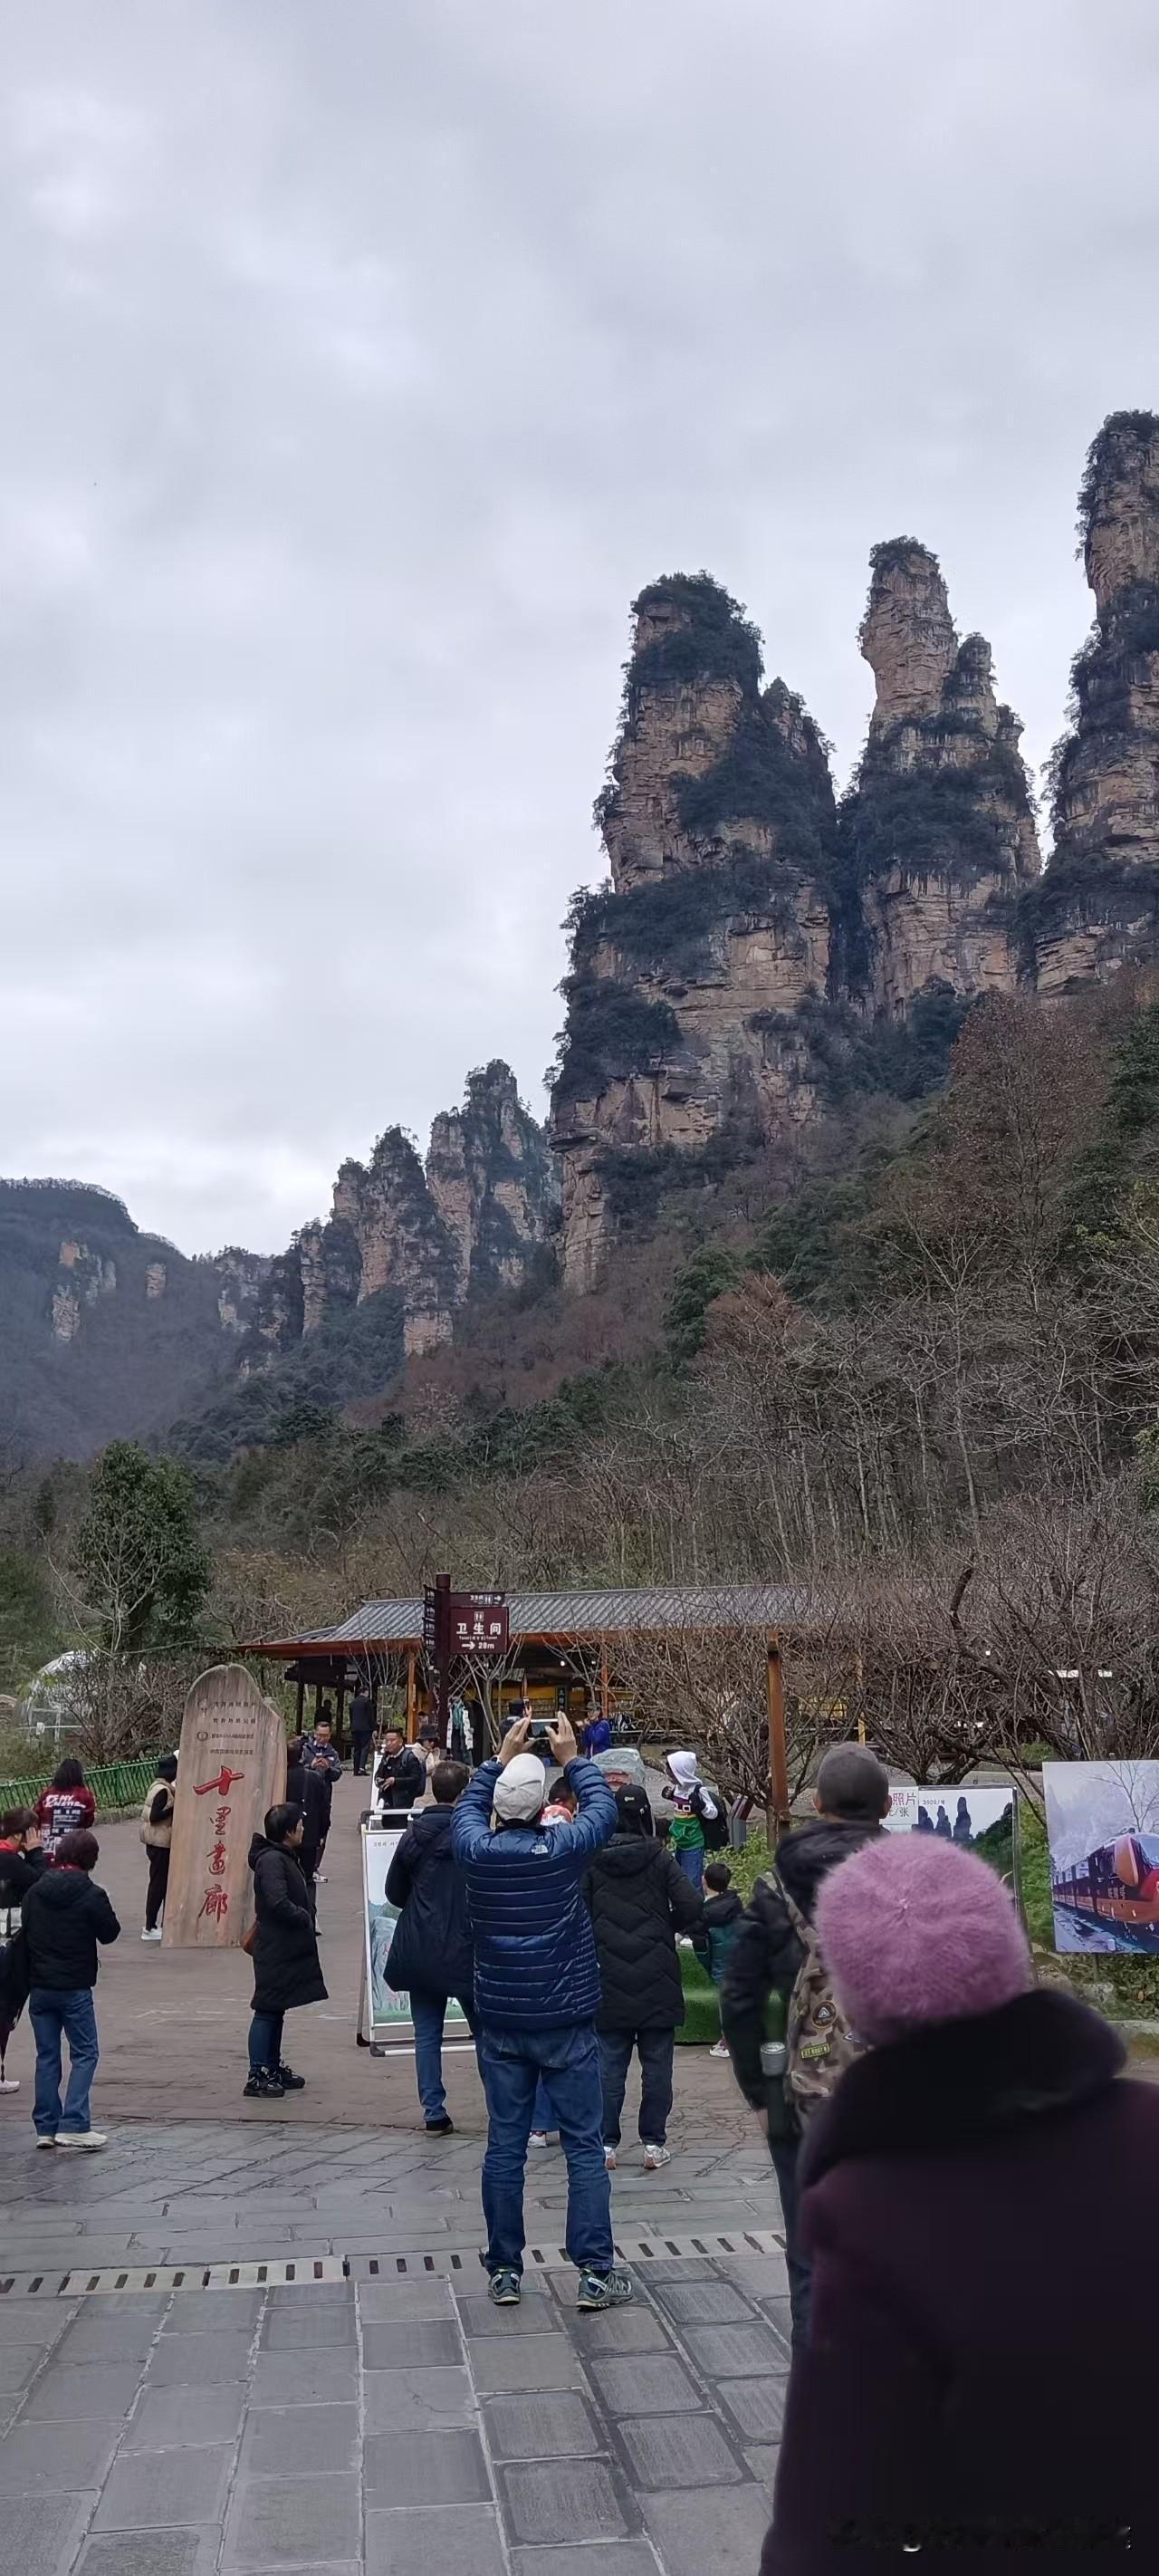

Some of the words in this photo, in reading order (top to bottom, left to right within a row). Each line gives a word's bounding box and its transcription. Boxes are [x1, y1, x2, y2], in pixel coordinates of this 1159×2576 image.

[455, 1622, 502, 1635] 卫生间
[478, 1641, 494, 1649] 28m
